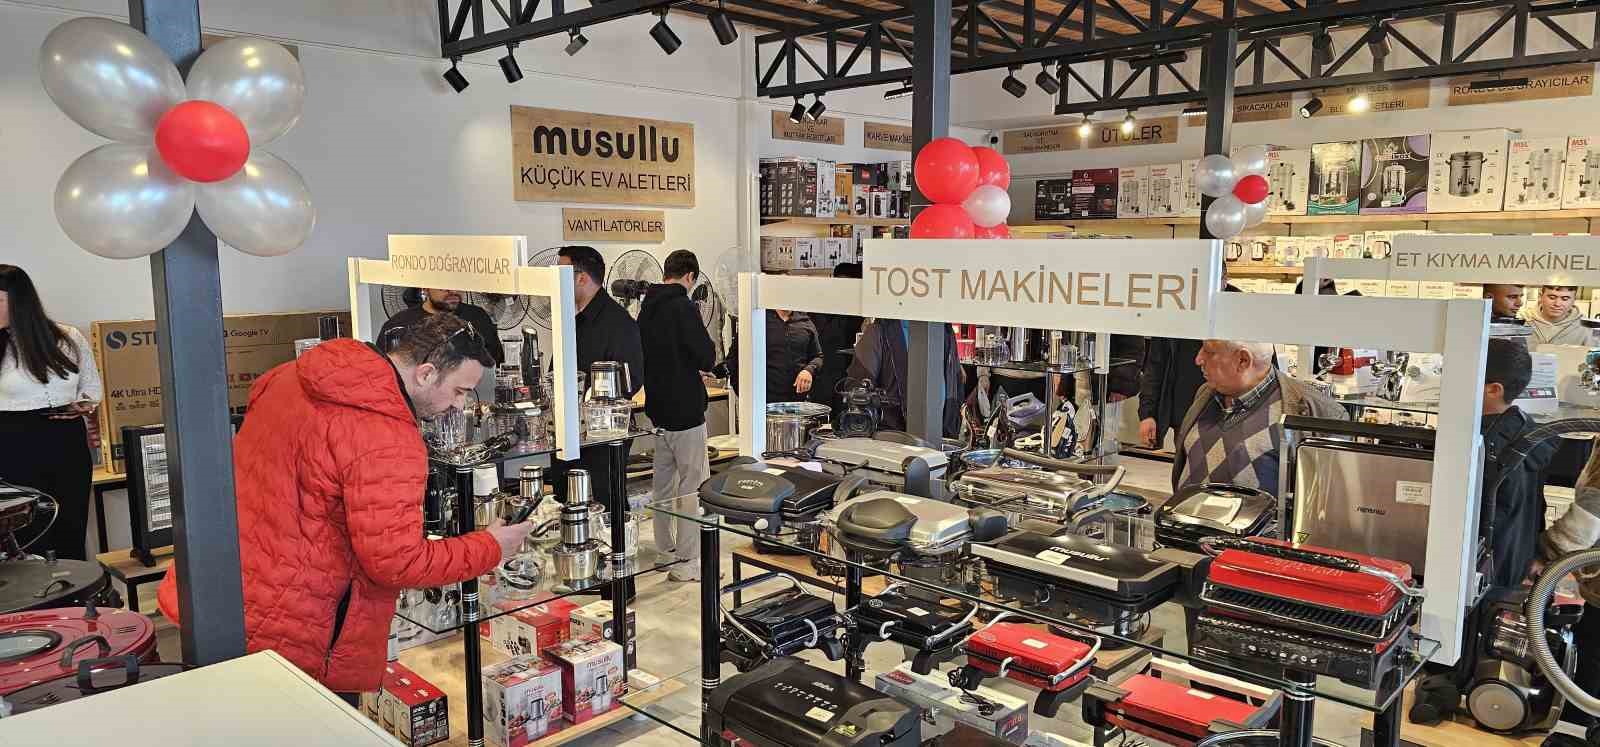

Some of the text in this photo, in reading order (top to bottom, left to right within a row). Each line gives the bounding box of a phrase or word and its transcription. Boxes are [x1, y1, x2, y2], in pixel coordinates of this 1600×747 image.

[1498, 75, 1590, 94] RAYICILAR
[533, 124, 680, 163] musullu
[521, 164, 691, 193] KÜÇÜK EV ALETLERİ
[568, 216, 664, 234] VANTİLATÖRLER
[391, 253, 511, 276] RONDO DOĞRAYICILAR
[1396, 251, 1600, 271] ET KIYMA MAKİNEL
[870, 265, 1200, 312] TOST MAKİNELERİ
[131, 331, 158, 346] ST
[230, 328, 270, 338] Google TV
